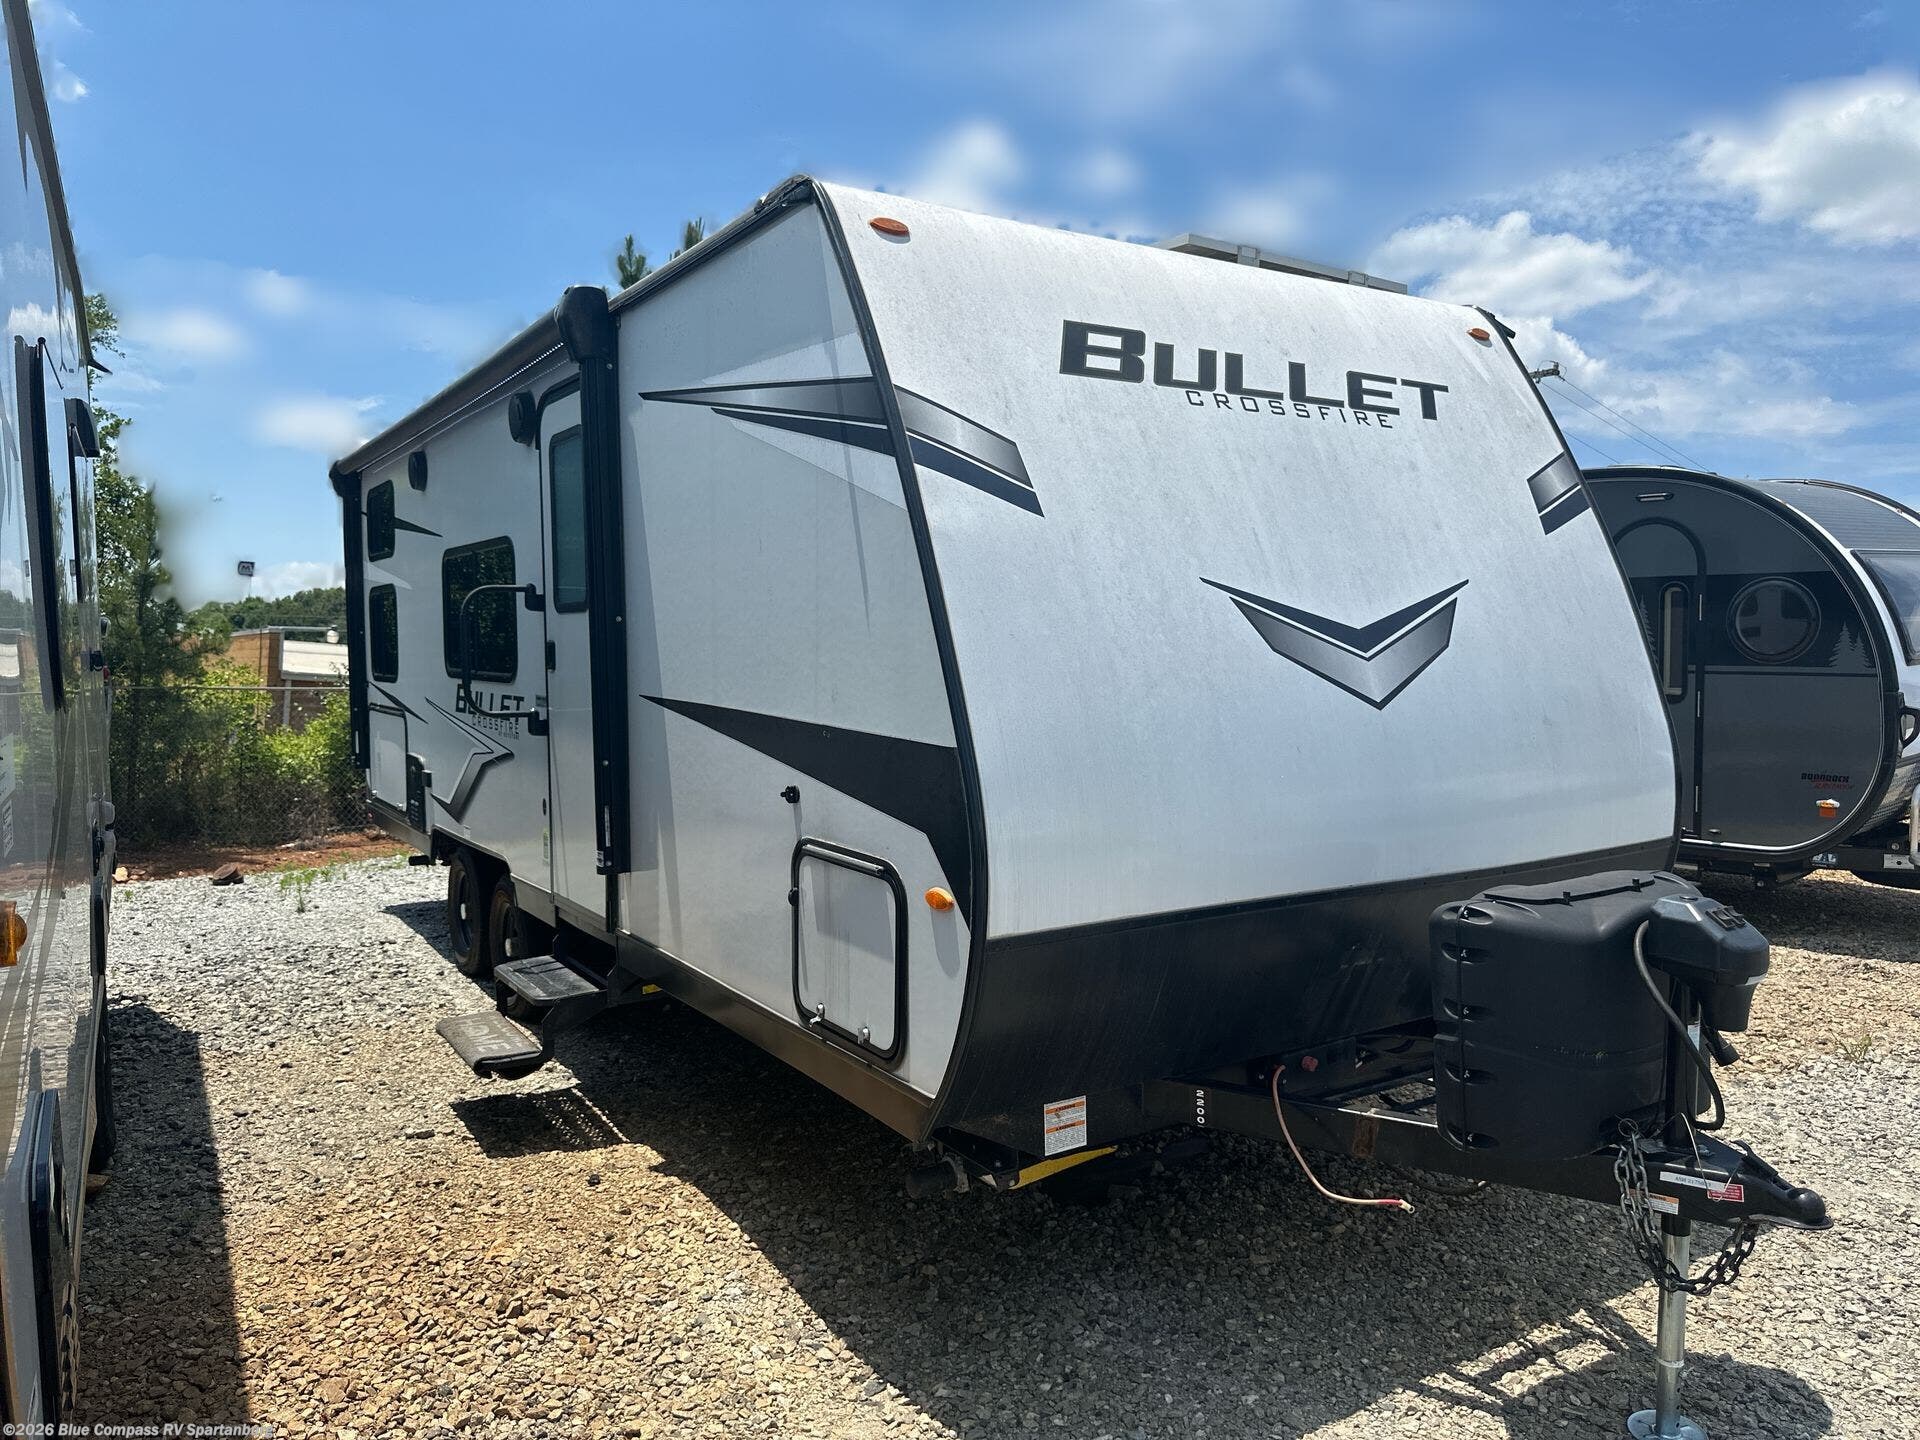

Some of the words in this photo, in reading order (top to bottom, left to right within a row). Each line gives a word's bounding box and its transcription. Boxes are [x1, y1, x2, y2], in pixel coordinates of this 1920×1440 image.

[1059, 319, 1449, 421] BULLET
[1186, 390, 1394, 429] CROSSFIRE
[472, 714, 520, 736] CROSSFIRE
